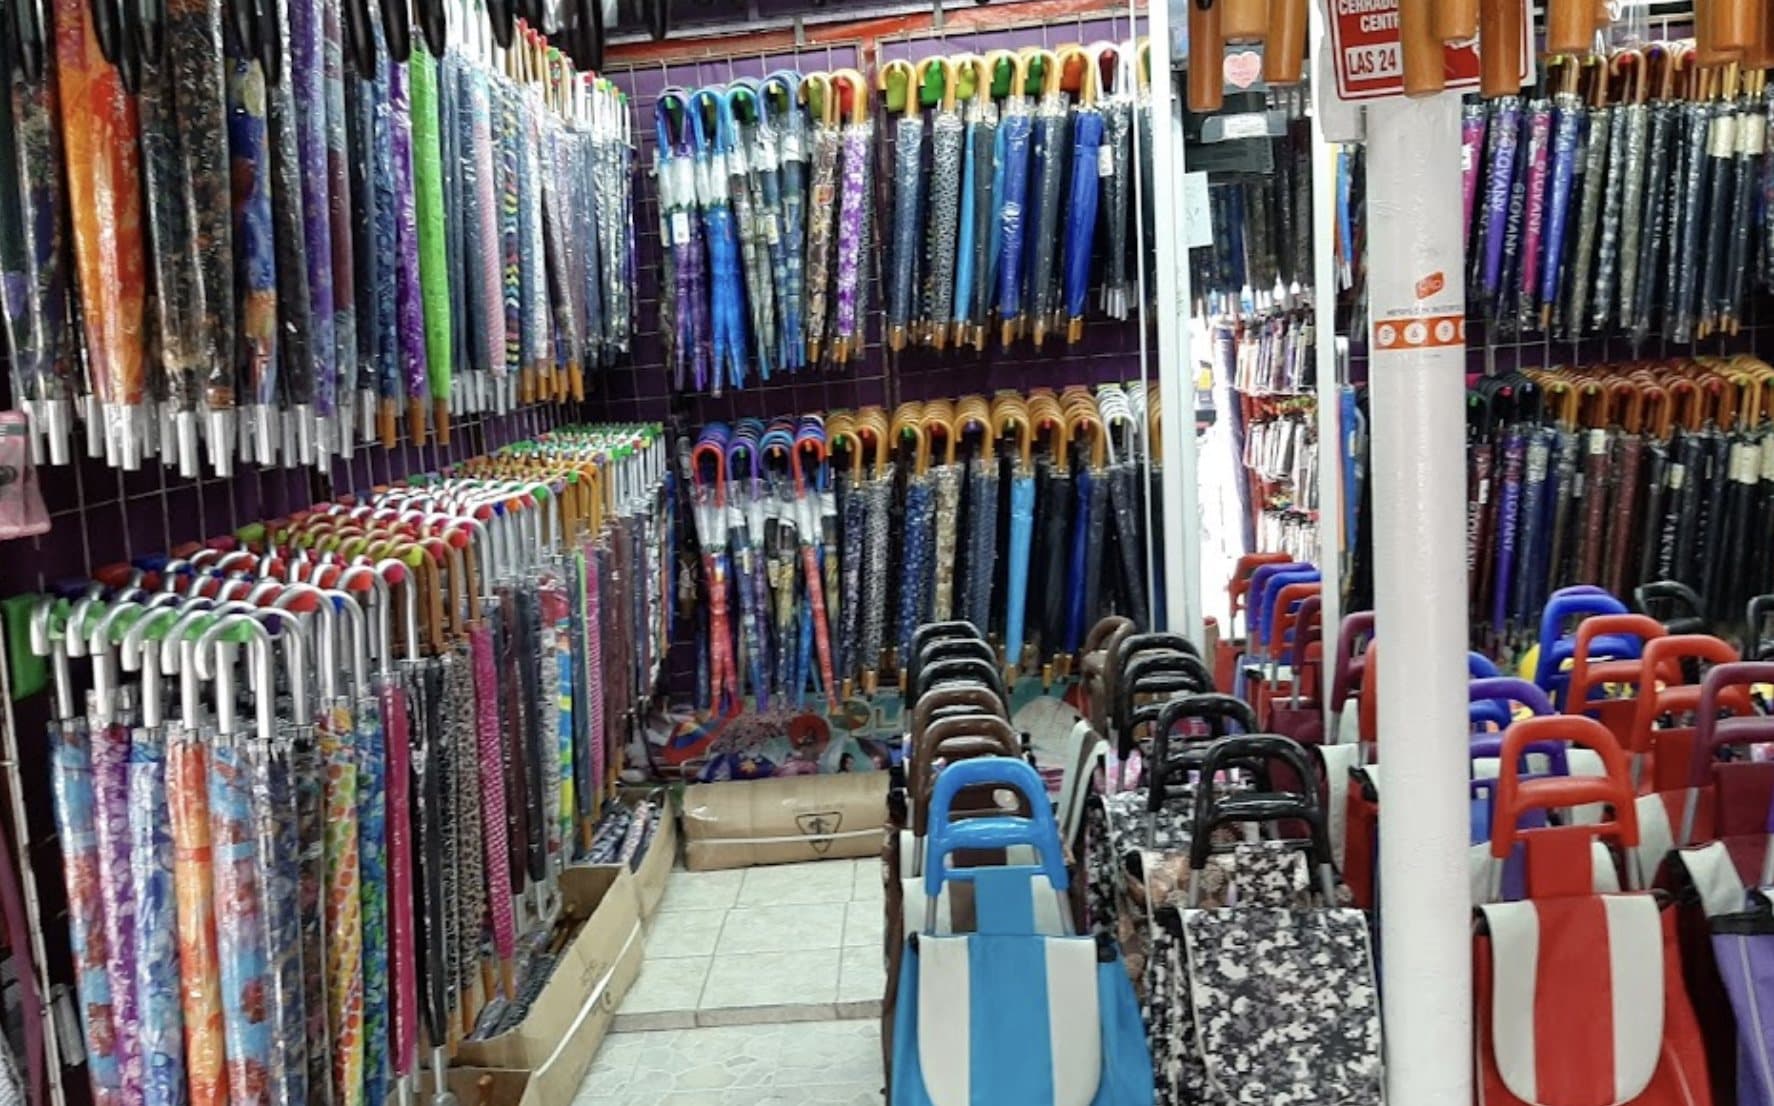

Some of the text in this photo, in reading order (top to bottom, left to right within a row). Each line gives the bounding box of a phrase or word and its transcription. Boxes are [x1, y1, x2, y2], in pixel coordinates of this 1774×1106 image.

[1348, 48, 1396, 75] LAS 24
[1491, 139, 1513, 213] GIOVANY
[1528, 160, 1547, 235] GIOVANY
[1504, 182, 1525, 257] GIOVANY
